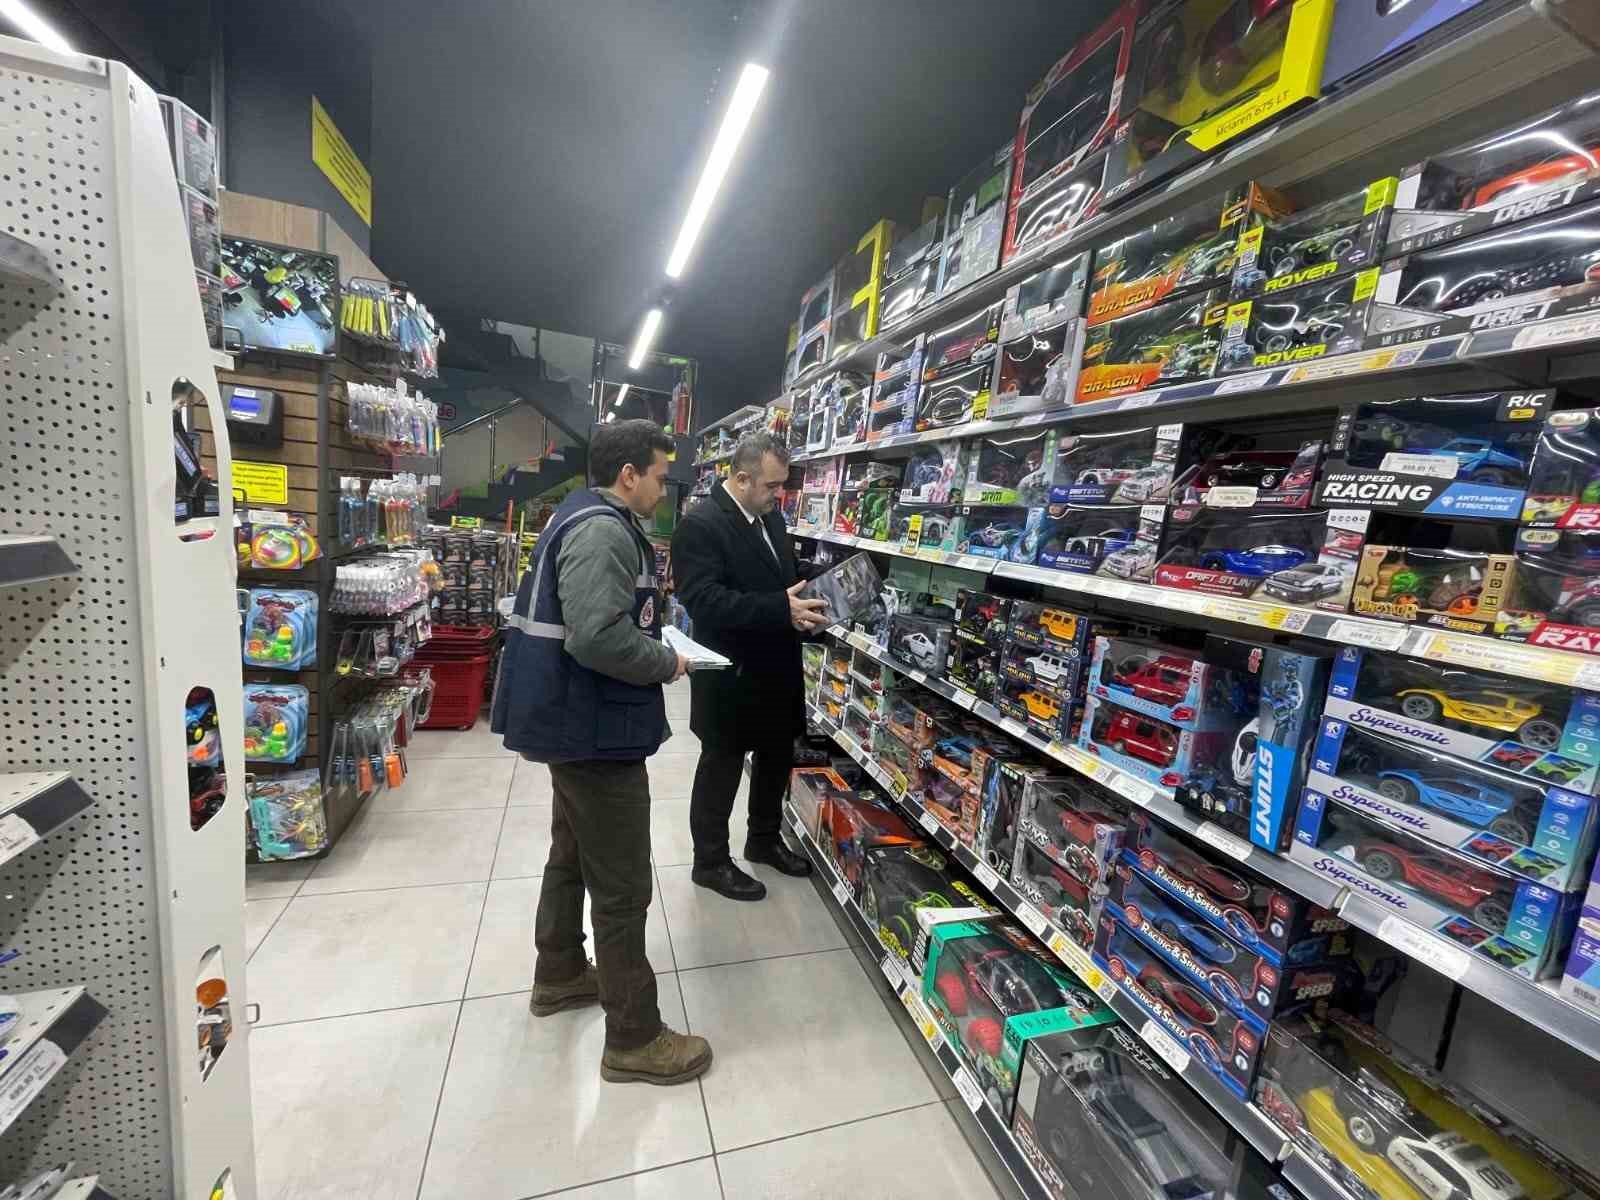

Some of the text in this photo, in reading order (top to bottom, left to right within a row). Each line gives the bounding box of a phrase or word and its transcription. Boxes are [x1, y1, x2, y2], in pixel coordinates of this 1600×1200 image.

[1492, 185, 1583, 224] DRIFT
[1264, 261, 1337, 292] ROVER
[1095, 286, 1157, 315] DRAGON
[1471, 300, 1558, 329] DRIFT
[1253, 344, 1327, 366] ROVER
[1083, 373, 1142, 394] DRAGON
[1506, 393, 1546, 408] R/C
[1327, 474, 1395, 483] HIGH SPEED
[1322, 482, 1433, 502] RACING
[1455, 502, 1510, 511] STRUCTURE
[1184, 571, 1257, 587] DRIFT STUNT
[1349, 708, 1451, 746] Supersonic
[1255, 745, 1274, 846] STUNT
[1331, 785, 1432, 830] Supersonic
[1313, 858, 1408, 910] Supersonic
[1296, 983, 1333, 1001] SPEED
